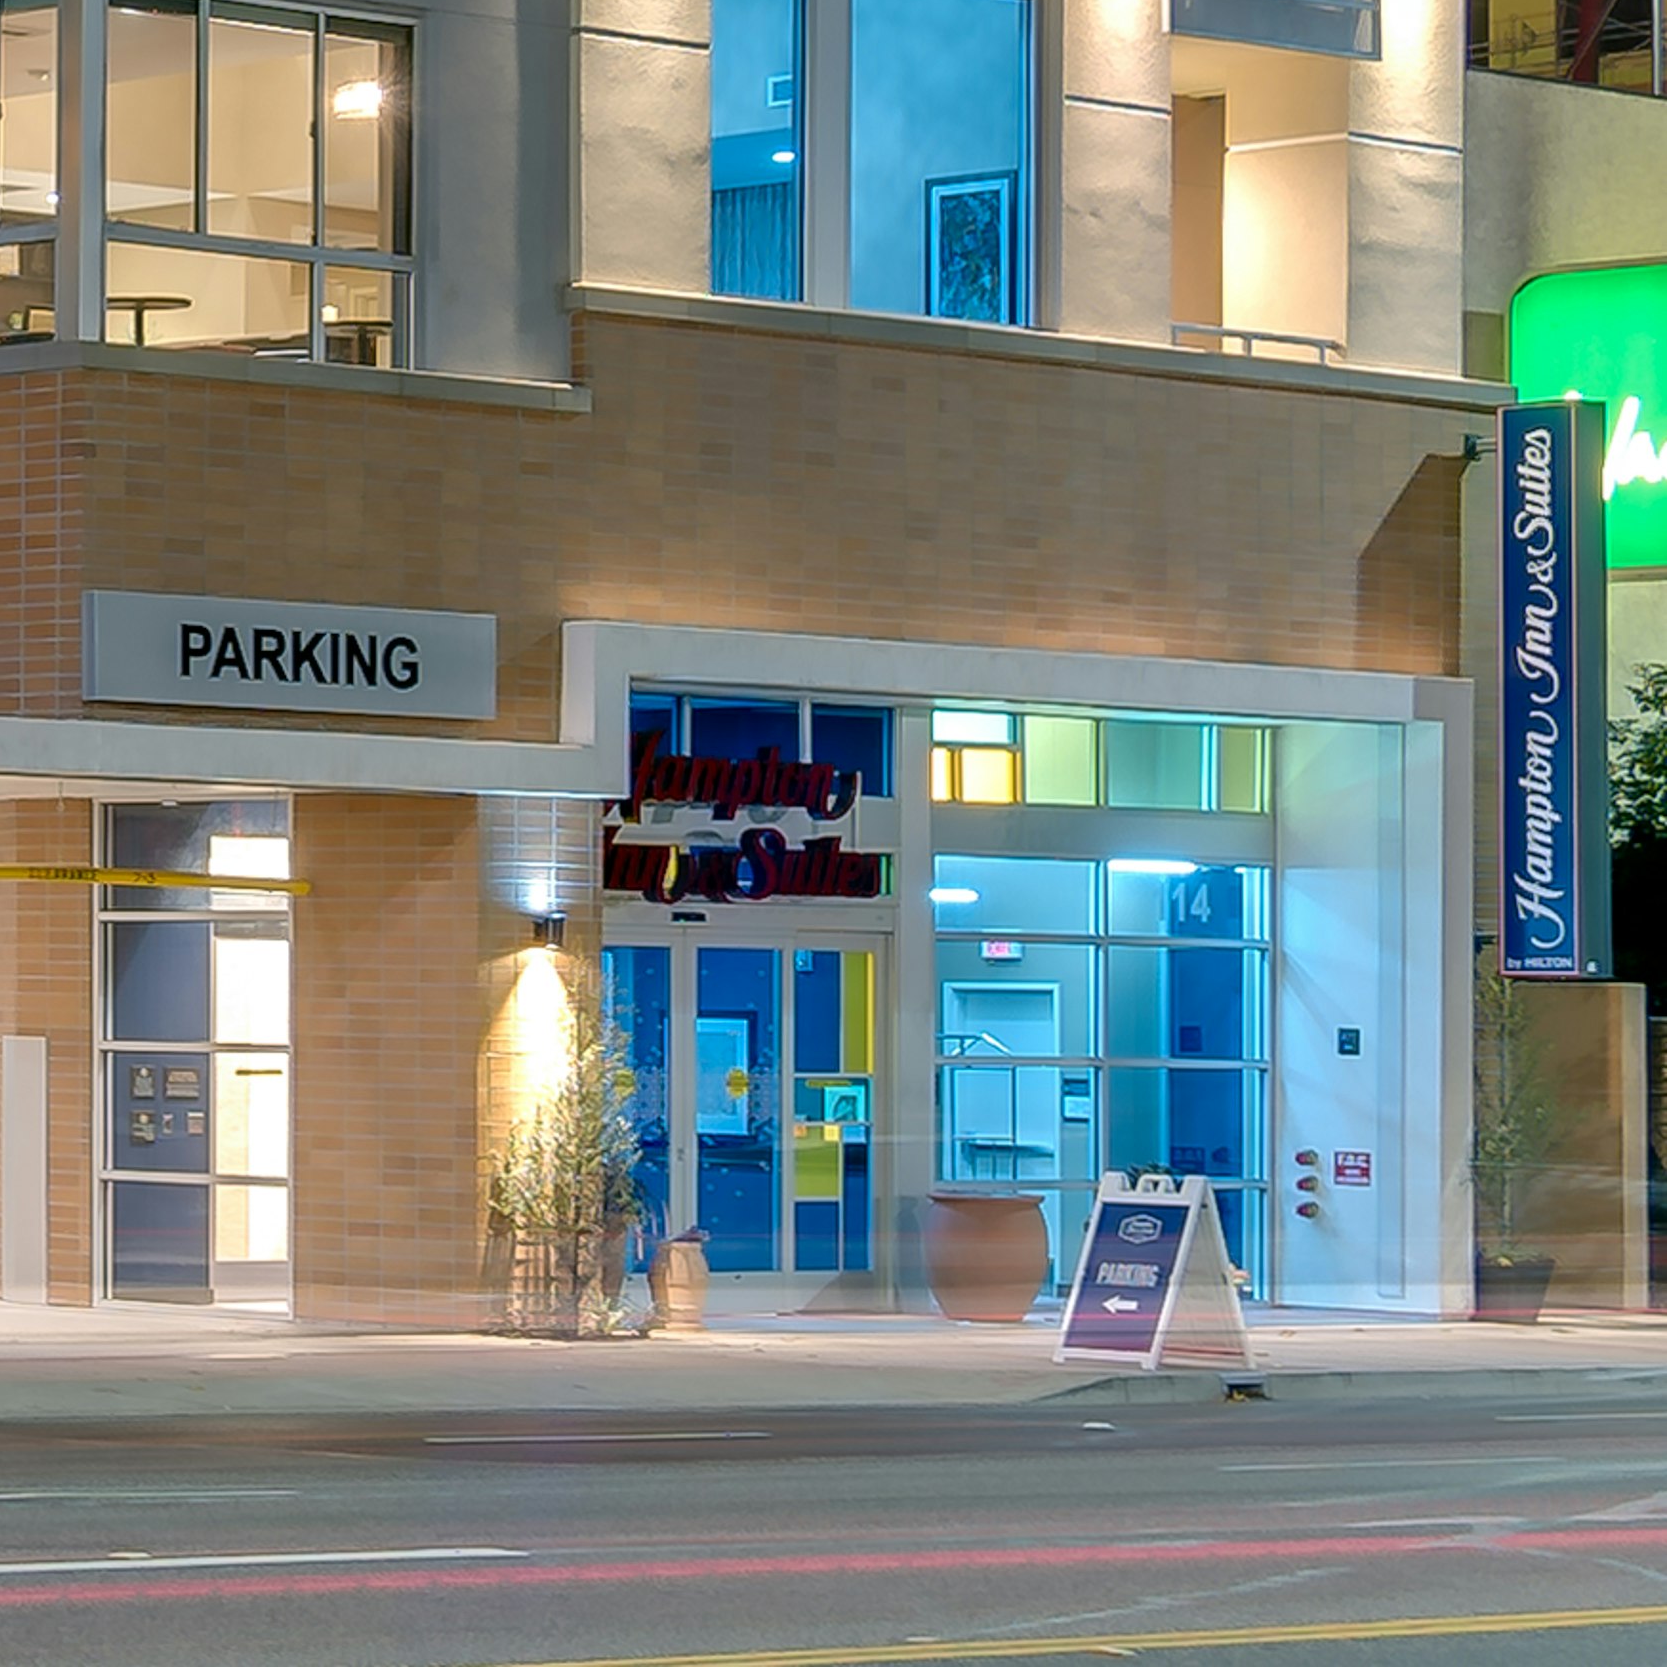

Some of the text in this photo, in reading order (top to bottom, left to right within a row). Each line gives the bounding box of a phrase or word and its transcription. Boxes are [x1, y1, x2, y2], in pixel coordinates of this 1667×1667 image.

[179, 622, 421, 691] PARKING
[1514, 427, 1566, 950] Hampton Inn & Suites
[604, 832, 694, 905] nn
[734, 827, 882, 901] Suites
[1525, 956, 1573, 969] HILTON
[1096, 1261, 1159, 1287] PARKING
